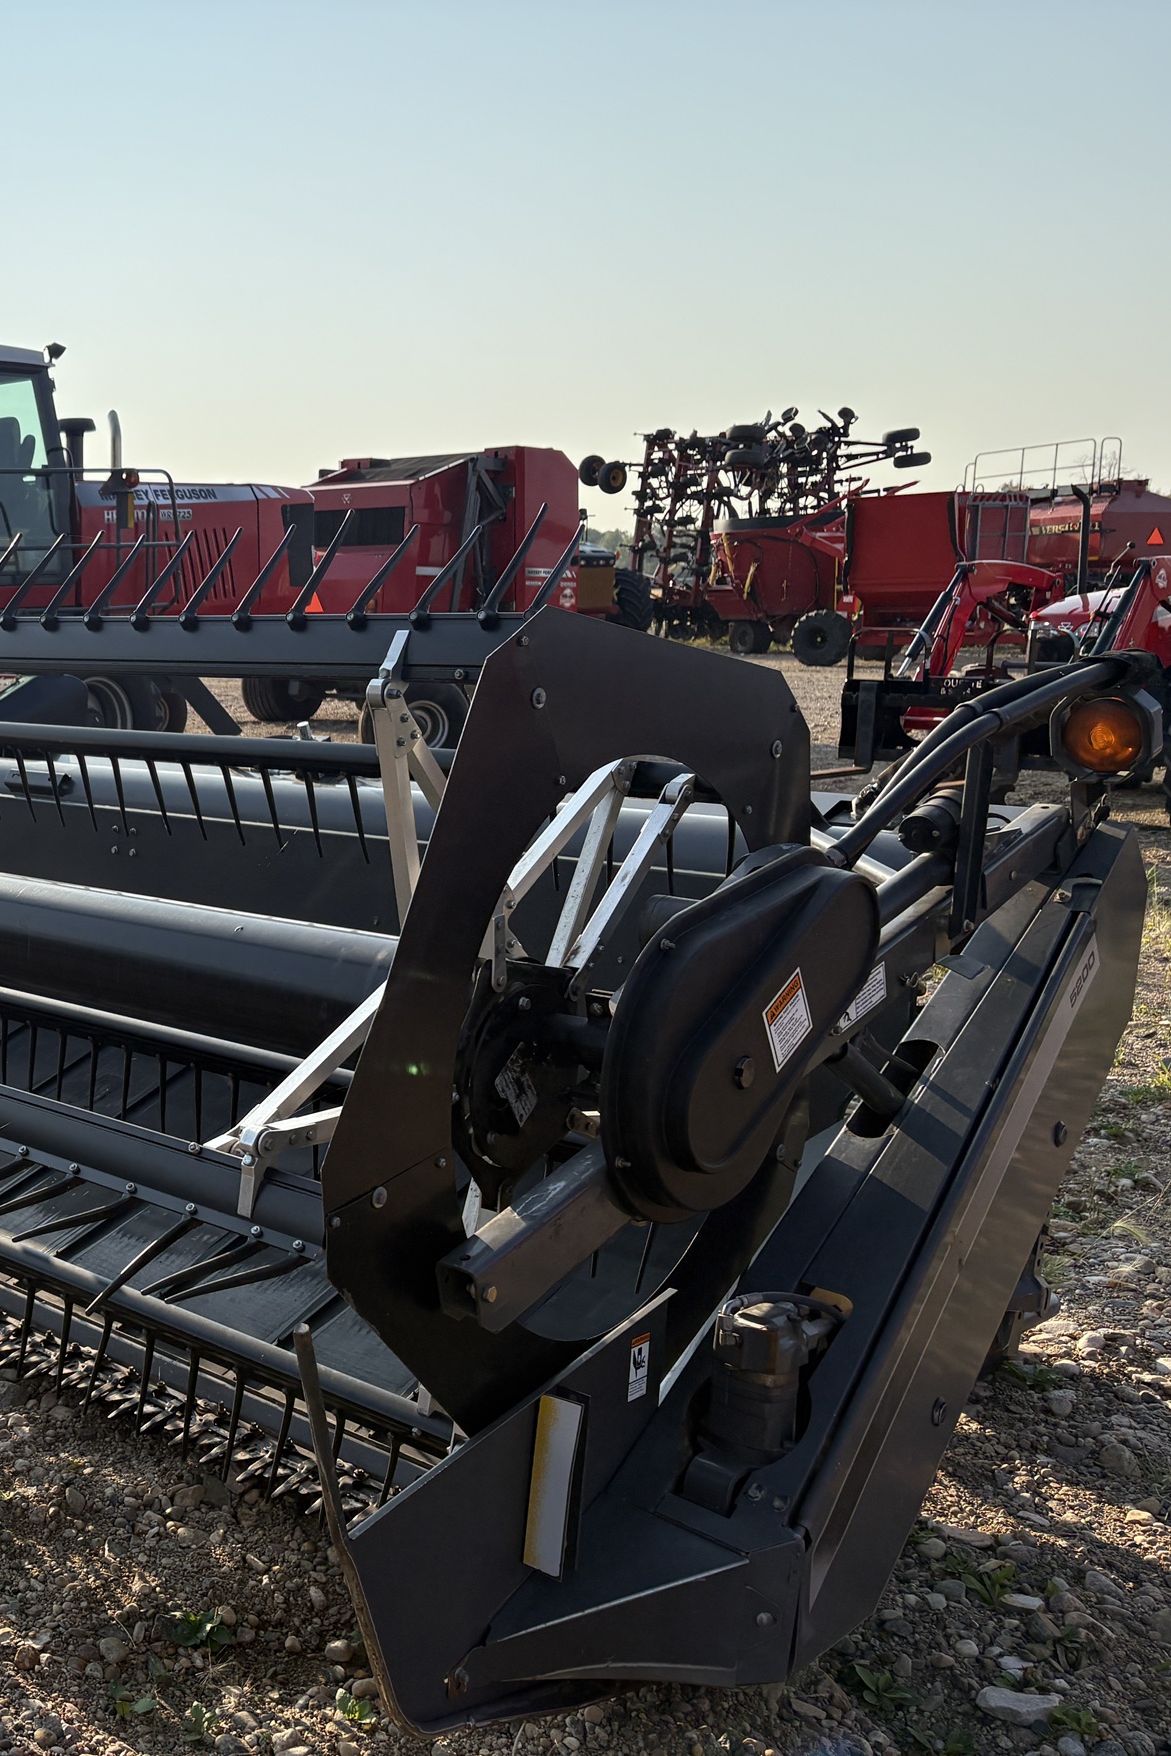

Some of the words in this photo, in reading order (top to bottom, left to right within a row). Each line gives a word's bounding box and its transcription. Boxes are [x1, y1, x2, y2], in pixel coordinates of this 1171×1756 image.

[160, 510, 192, 520] WR725
[1070, 950, 1095, 1008] 5200
[773, 980, 799, 1013] WARNING
